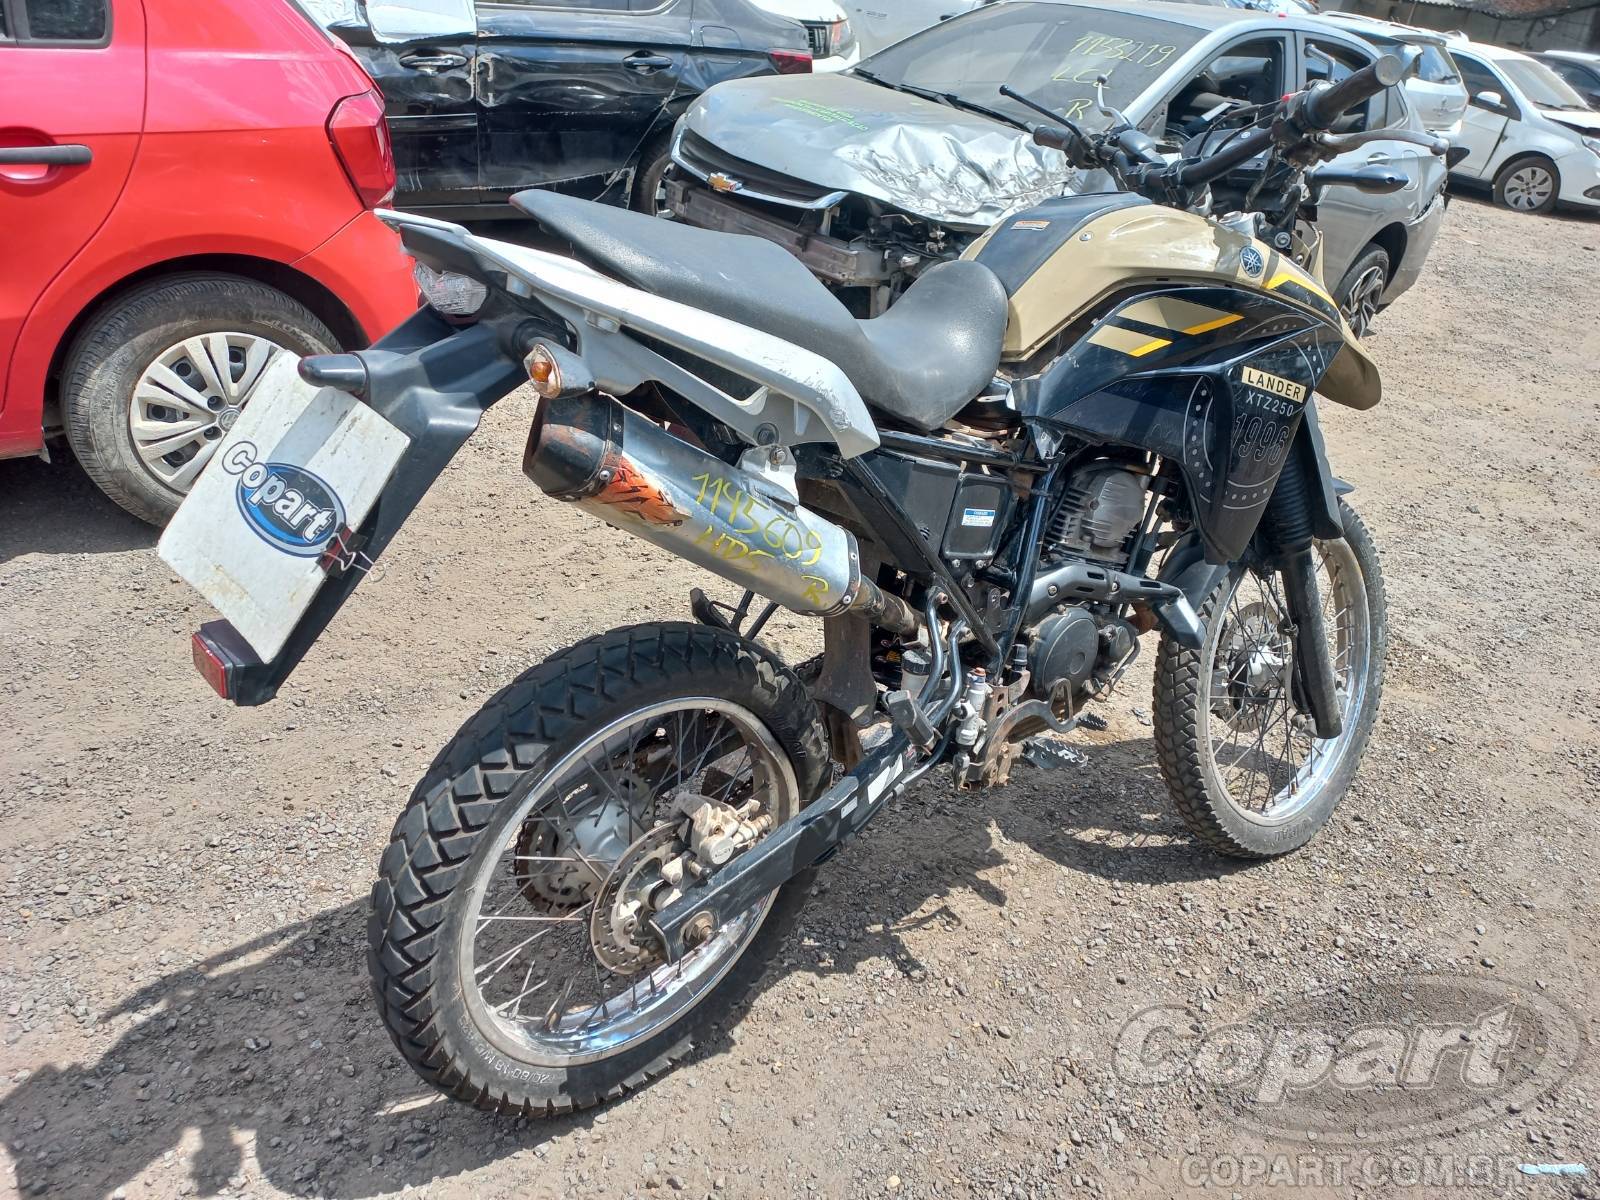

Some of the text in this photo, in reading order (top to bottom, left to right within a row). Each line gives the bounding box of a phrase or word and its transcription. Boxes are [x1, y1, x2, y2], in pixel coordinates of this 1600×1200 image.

[1070, 34, 1177, 68] 1153219
[1065, 98, 1093, 120] R
[1247, 369, 1301, 400] LANDER
[1246, 390, 1294, 417] XTZ250
[1232, 412, 1290, 466] 1996
[221, 440, 337, 543] Copart
[692, 472, 823, 566] 1145609
[801, 574, 829, 605] R
